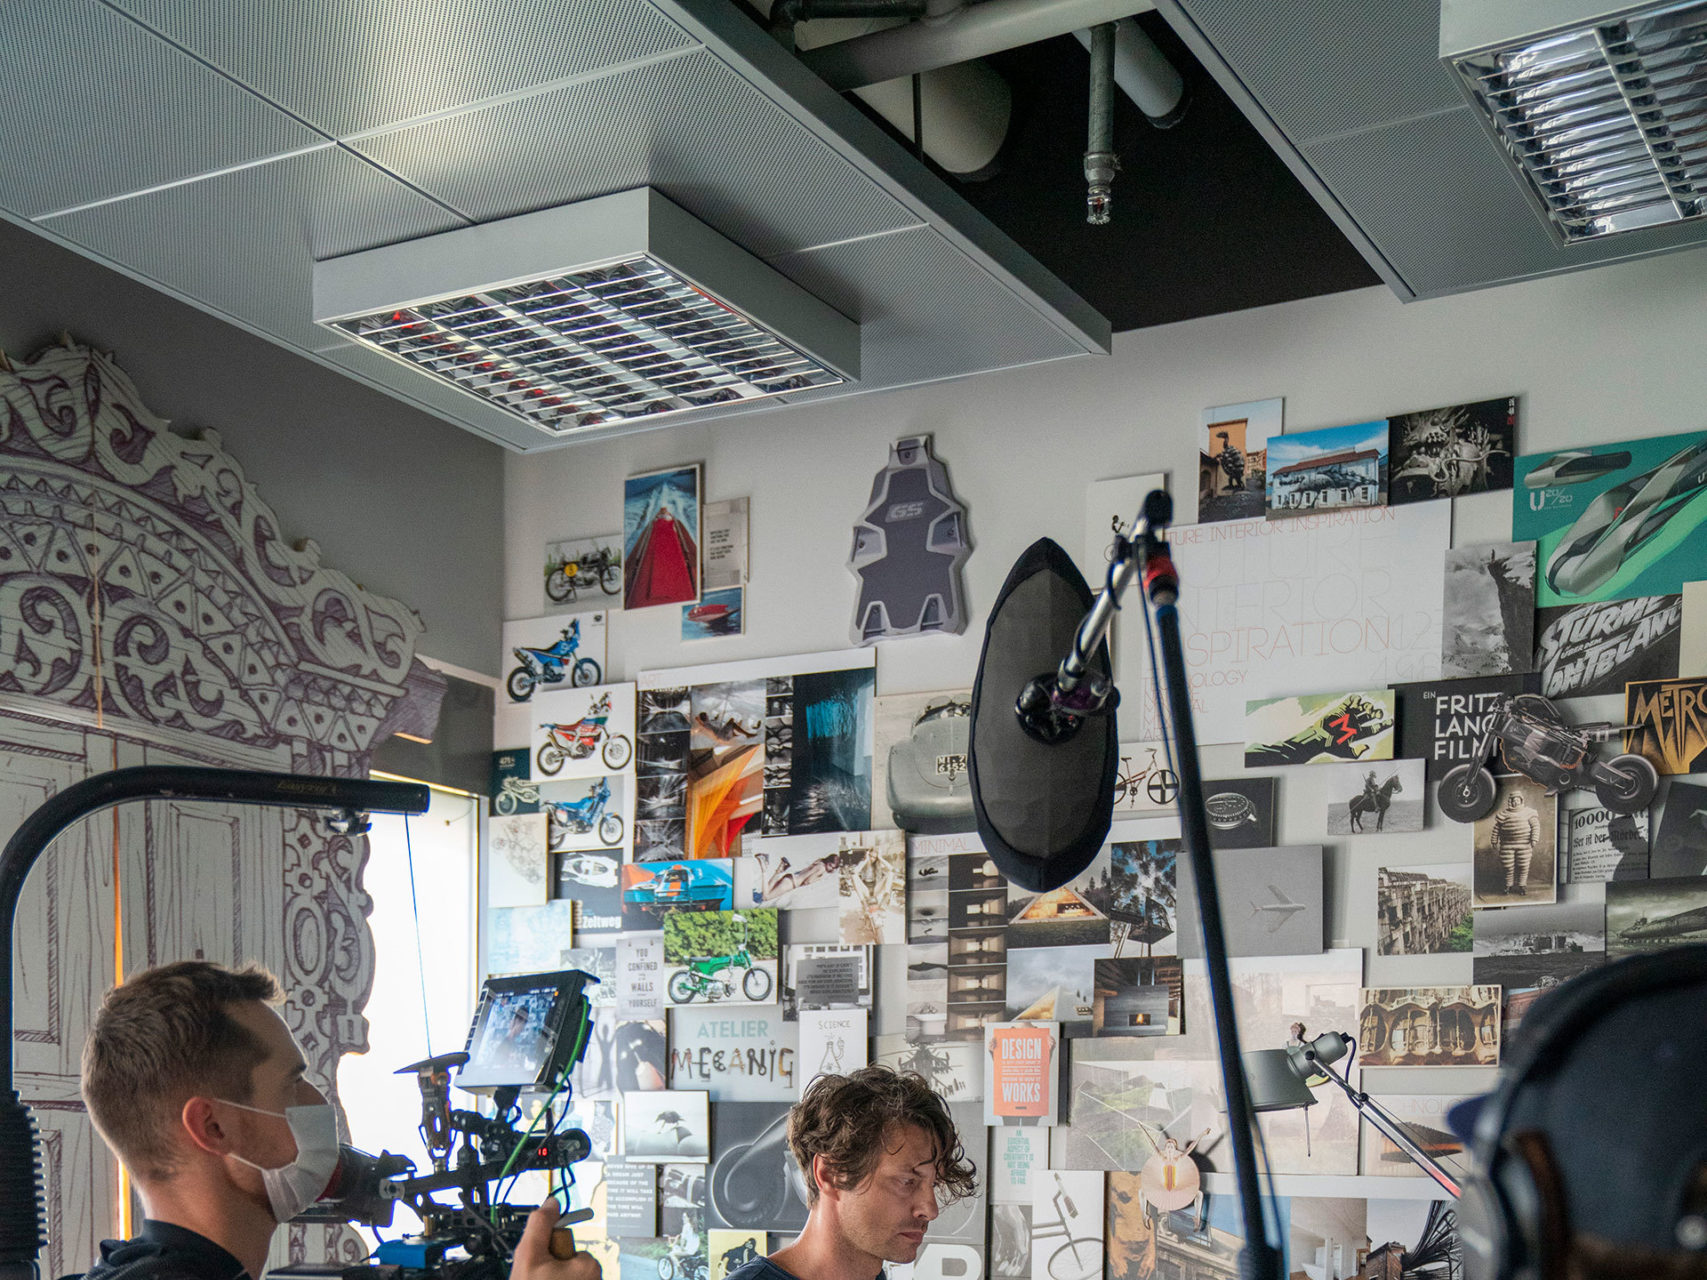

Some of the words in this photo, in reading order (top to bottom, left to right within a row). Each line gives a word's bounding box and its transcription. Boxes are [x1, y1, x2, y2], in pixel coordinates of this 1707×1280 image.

[1423, 691, 1436, 699] EIN
[1436, 692, 1503, 715] FRITZ
[636, 948, 649, 958] YOU
[628, 962, 658, 972] CONFINED
[631, 982, 654, 992] WALLS
[629, 999, 657, 1008] YOURSELF
[697, 1020, 769, 1039] ATELIER
[818, 1020, 852, 1030] SCIENCE
[1001, 1037, 1042, 1060] DESIGN
[1001, 1082, 1041, 1103] WORKS
[537, 1147, 548, 1156] 10
